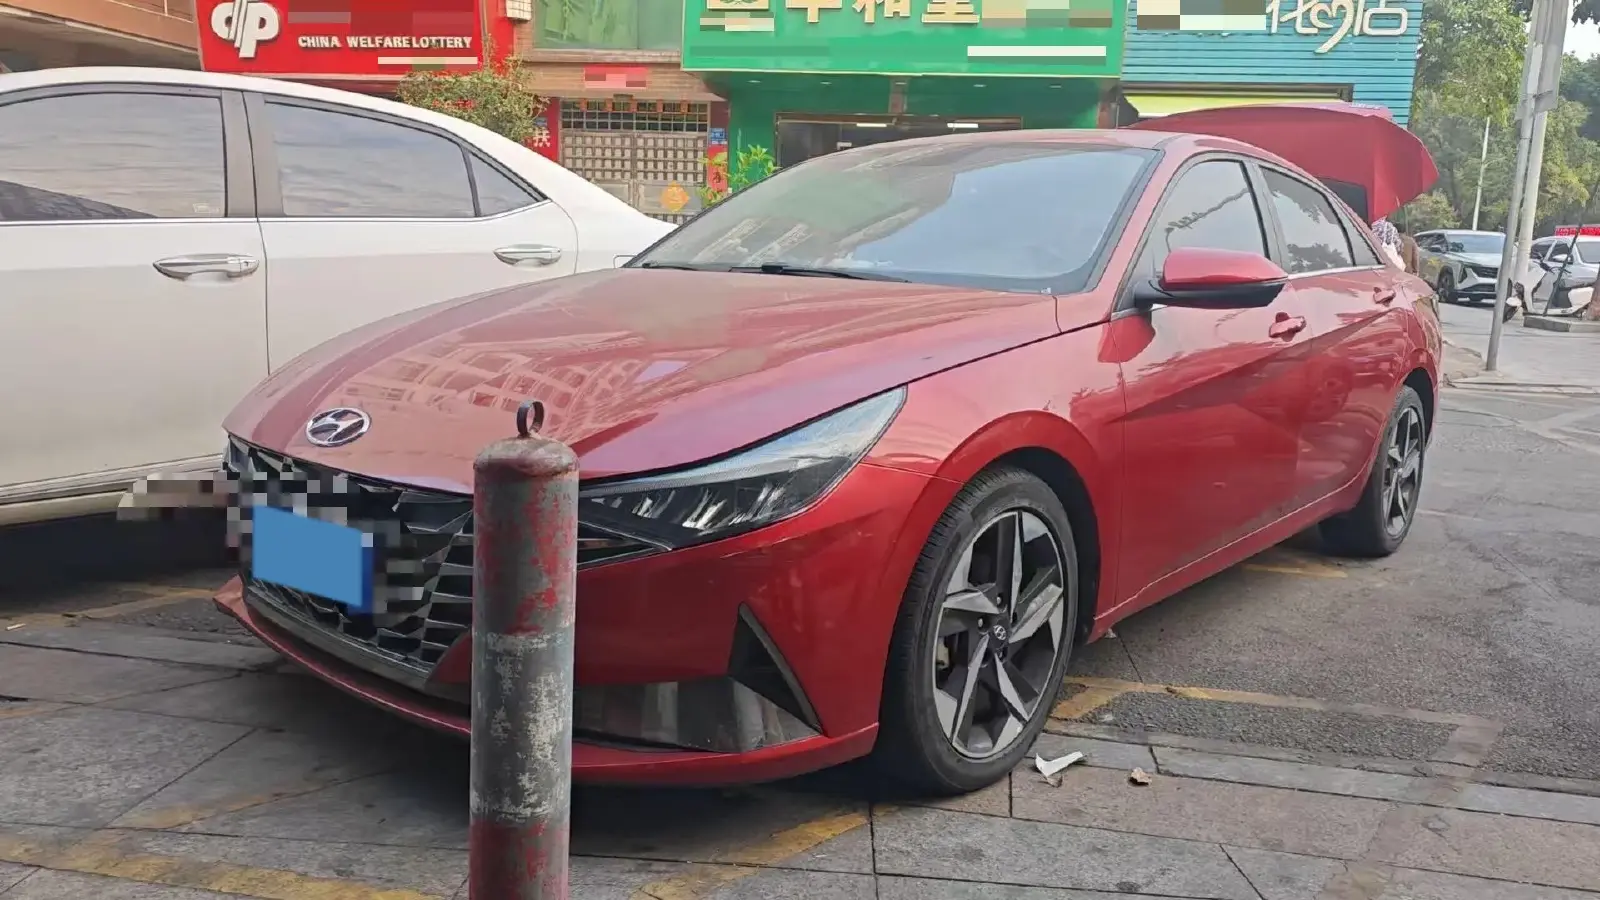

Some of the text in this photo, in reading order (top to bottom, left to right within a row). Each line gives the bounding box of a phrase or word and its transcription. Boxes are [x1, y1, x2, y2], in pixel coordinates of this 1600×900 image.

[297, 35, 473, 49] CHINA WELFARE LOTTERY
